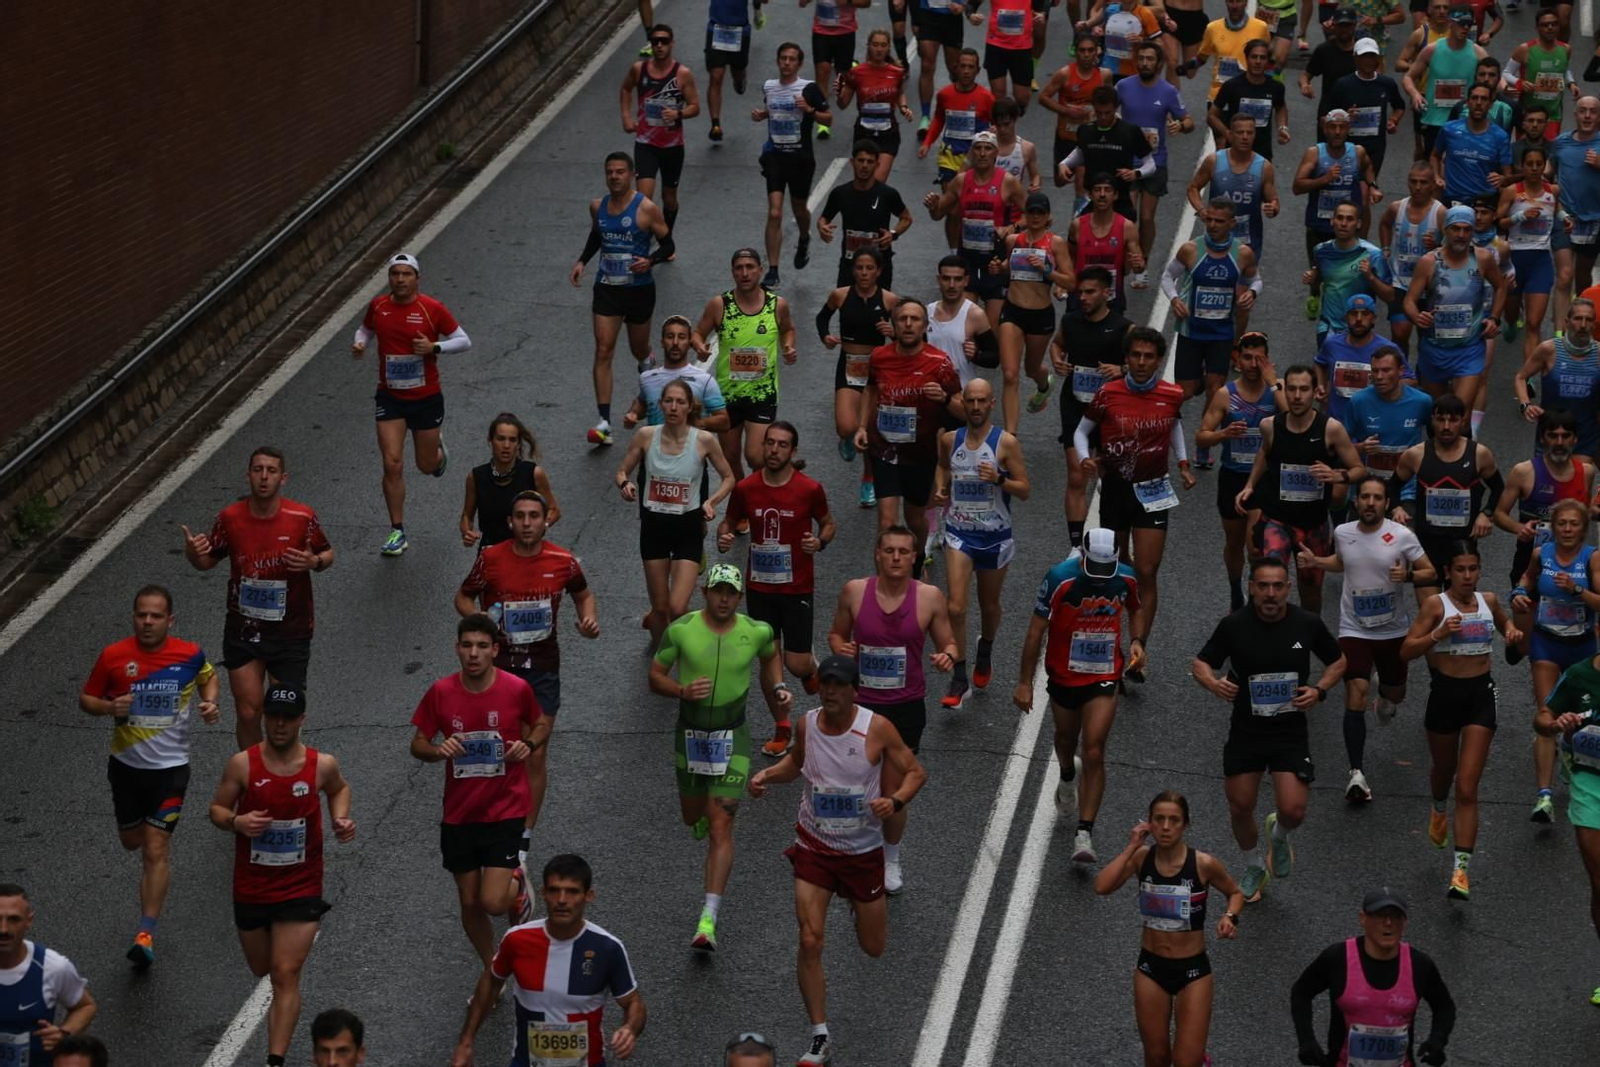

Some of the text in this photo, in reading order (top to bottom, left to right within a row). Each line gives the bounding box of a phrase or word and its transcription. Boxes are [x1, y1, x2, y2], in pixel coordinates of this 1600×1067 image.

[1329, 174, 1354, 186] DS
[1201, 294, 1224, 305] 2270
[735, 355, 759, 366] 5220
[882, 415, 906, 429] 3133
[1287, 473, 1314, 486] 3382
[655, 483, 680, 498] 1350
[959, 484, 984, 496] 3336
[1433, 497, 1460, 510] 3208
[755, 555, 782, 567] 2226
[246, 589, 276, 603] 2754
[1358, 599, 1386, 611] 3120
[512, 612, 542, 626] 2409
[864, 657, 894, 671] 2992
[272, 689, 297, 700] GEO
[1256, 684, 1287, 697] 2948
[138, 694, 171, 709] 1595
[820, 797, 854, 812] 2188
[532, 1033, 579, 1050] 13698
[1358, 1037, 1396, 1054] 1708
